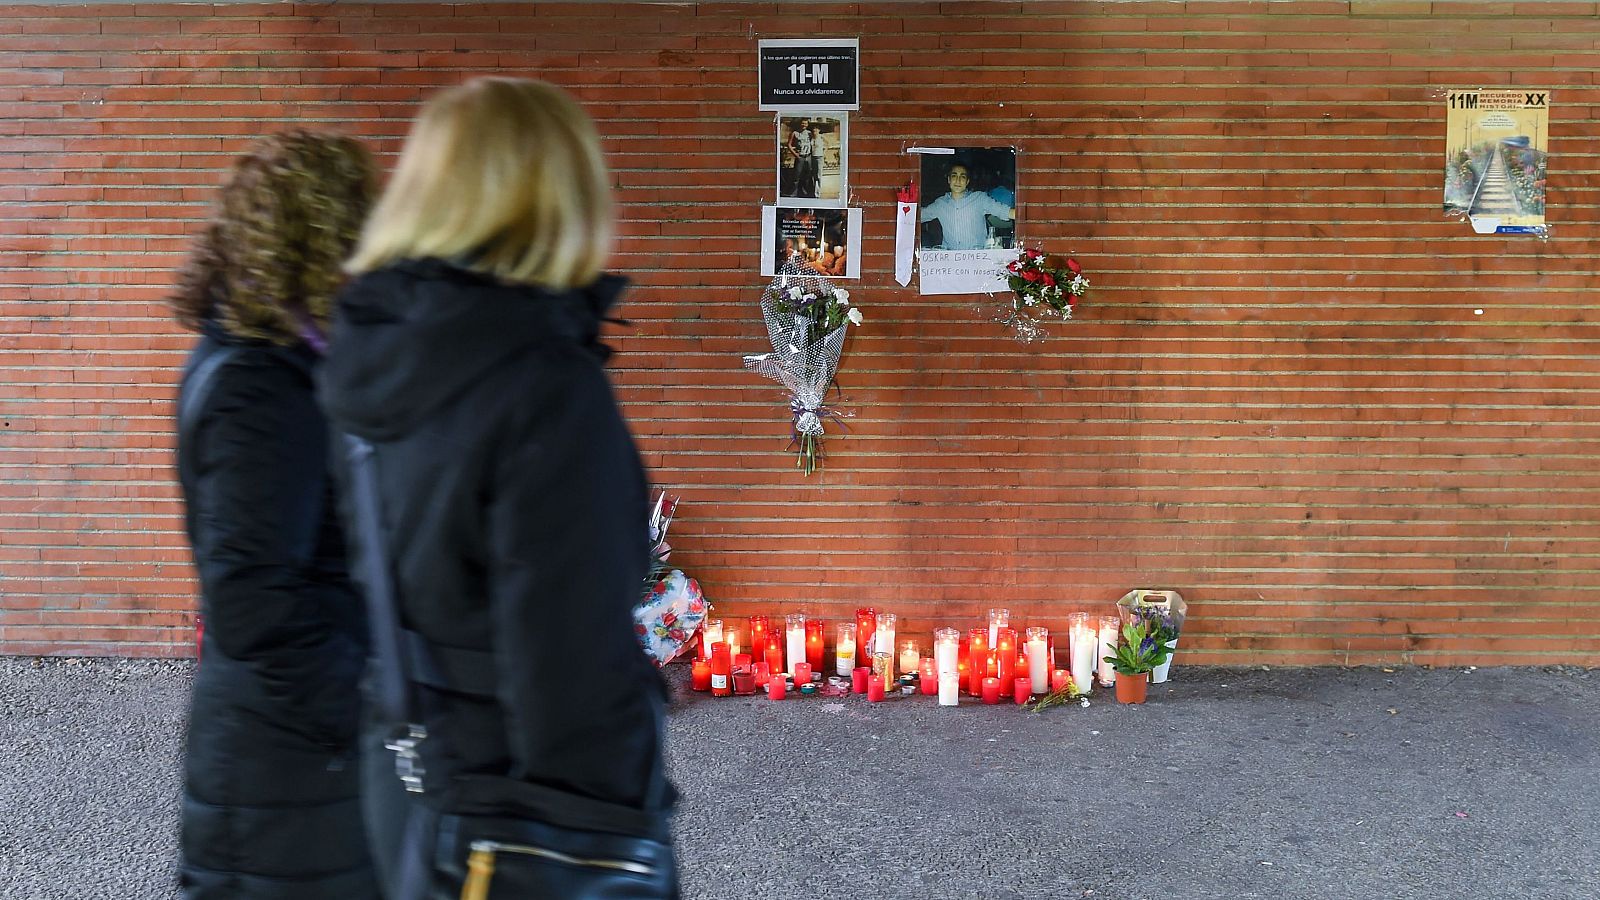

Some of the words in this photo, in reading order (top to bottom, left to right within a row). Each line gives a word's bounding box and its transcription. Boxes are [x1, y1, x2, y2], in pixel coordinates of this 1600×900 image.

[788, 63, 829, 84] 11-M
[1449, 93, 1478, 109] 11M
[1525, 93, 1546, 105] XX
[922, 252, 950, 262] OSKAR
[955, 252, 991, 261] GOMEZ
